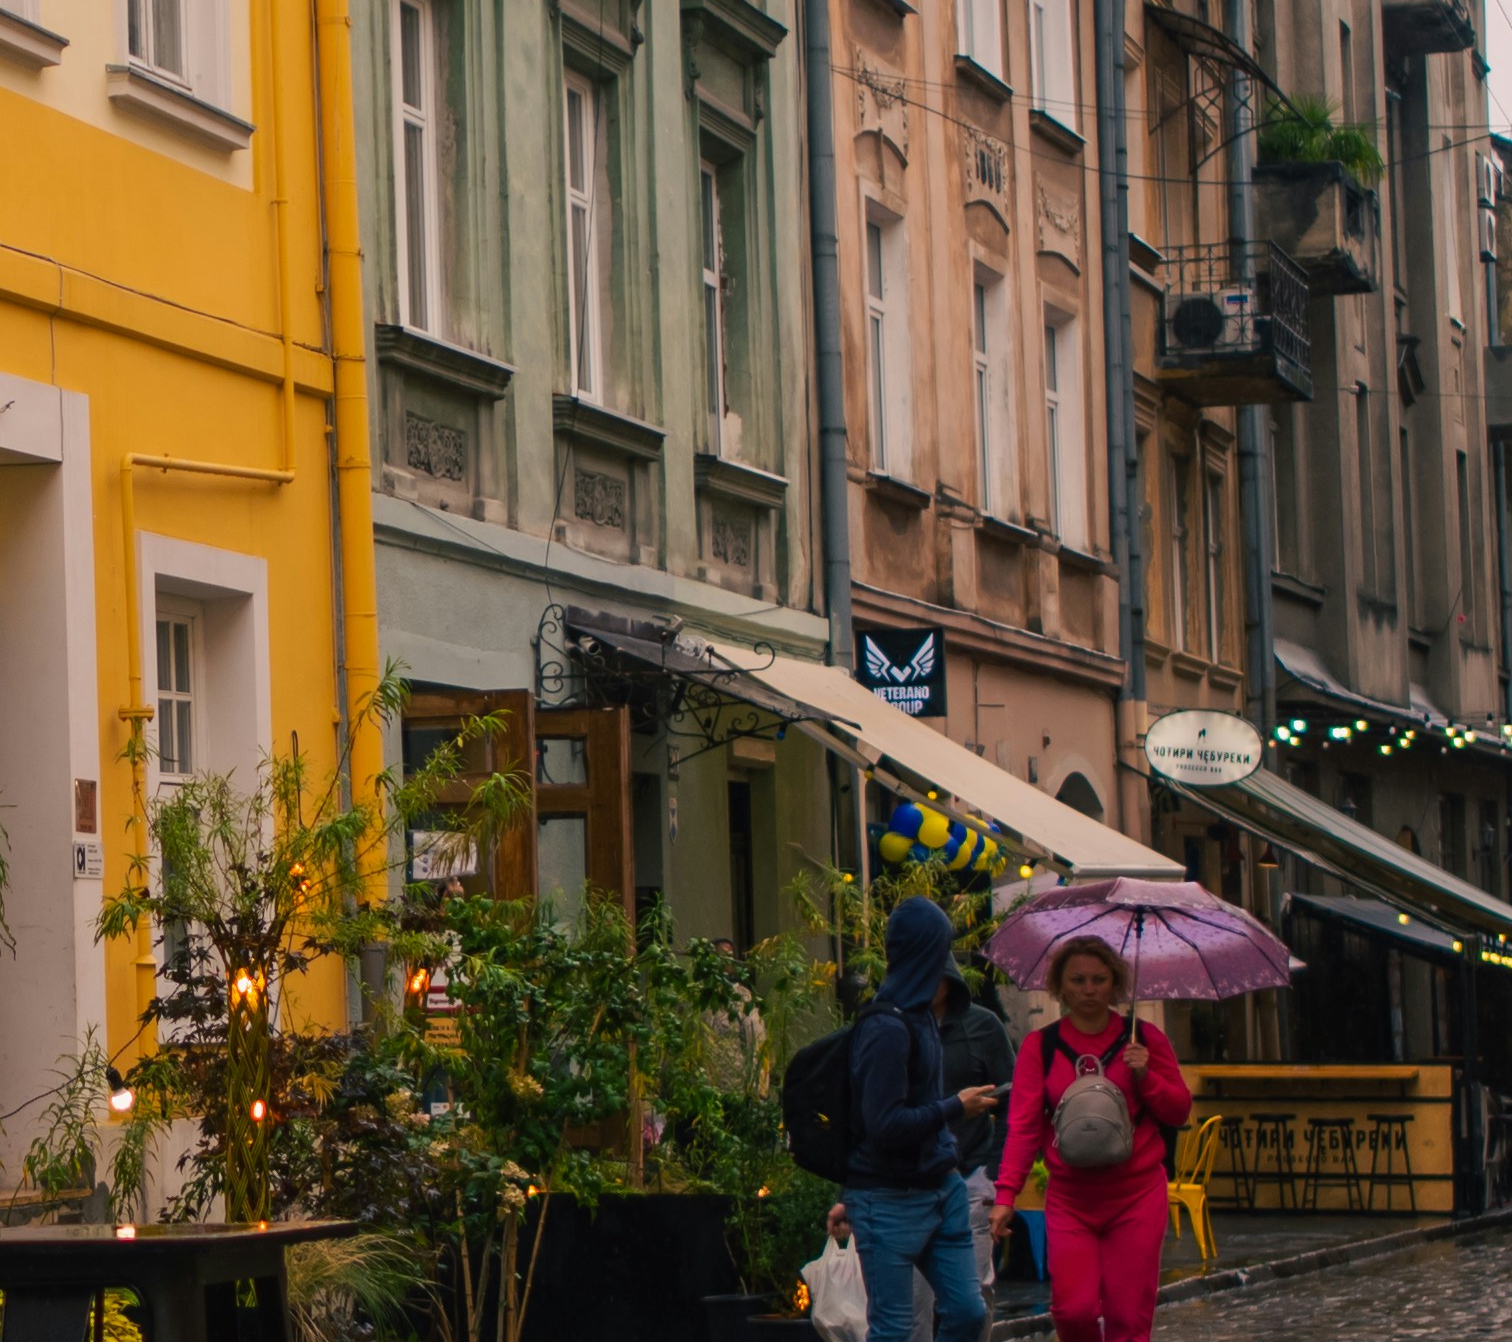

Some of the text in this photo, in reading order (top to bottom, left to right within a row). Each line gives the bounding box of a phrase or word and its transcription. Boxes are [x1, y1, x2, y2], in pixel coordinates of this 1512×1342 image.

[873, 686, 930, 700] VETERANO
[1154, 746, 1193, 759] ЧОТИРИ
[1219, 1128, 1294, 1148] ЧОТИРИ
